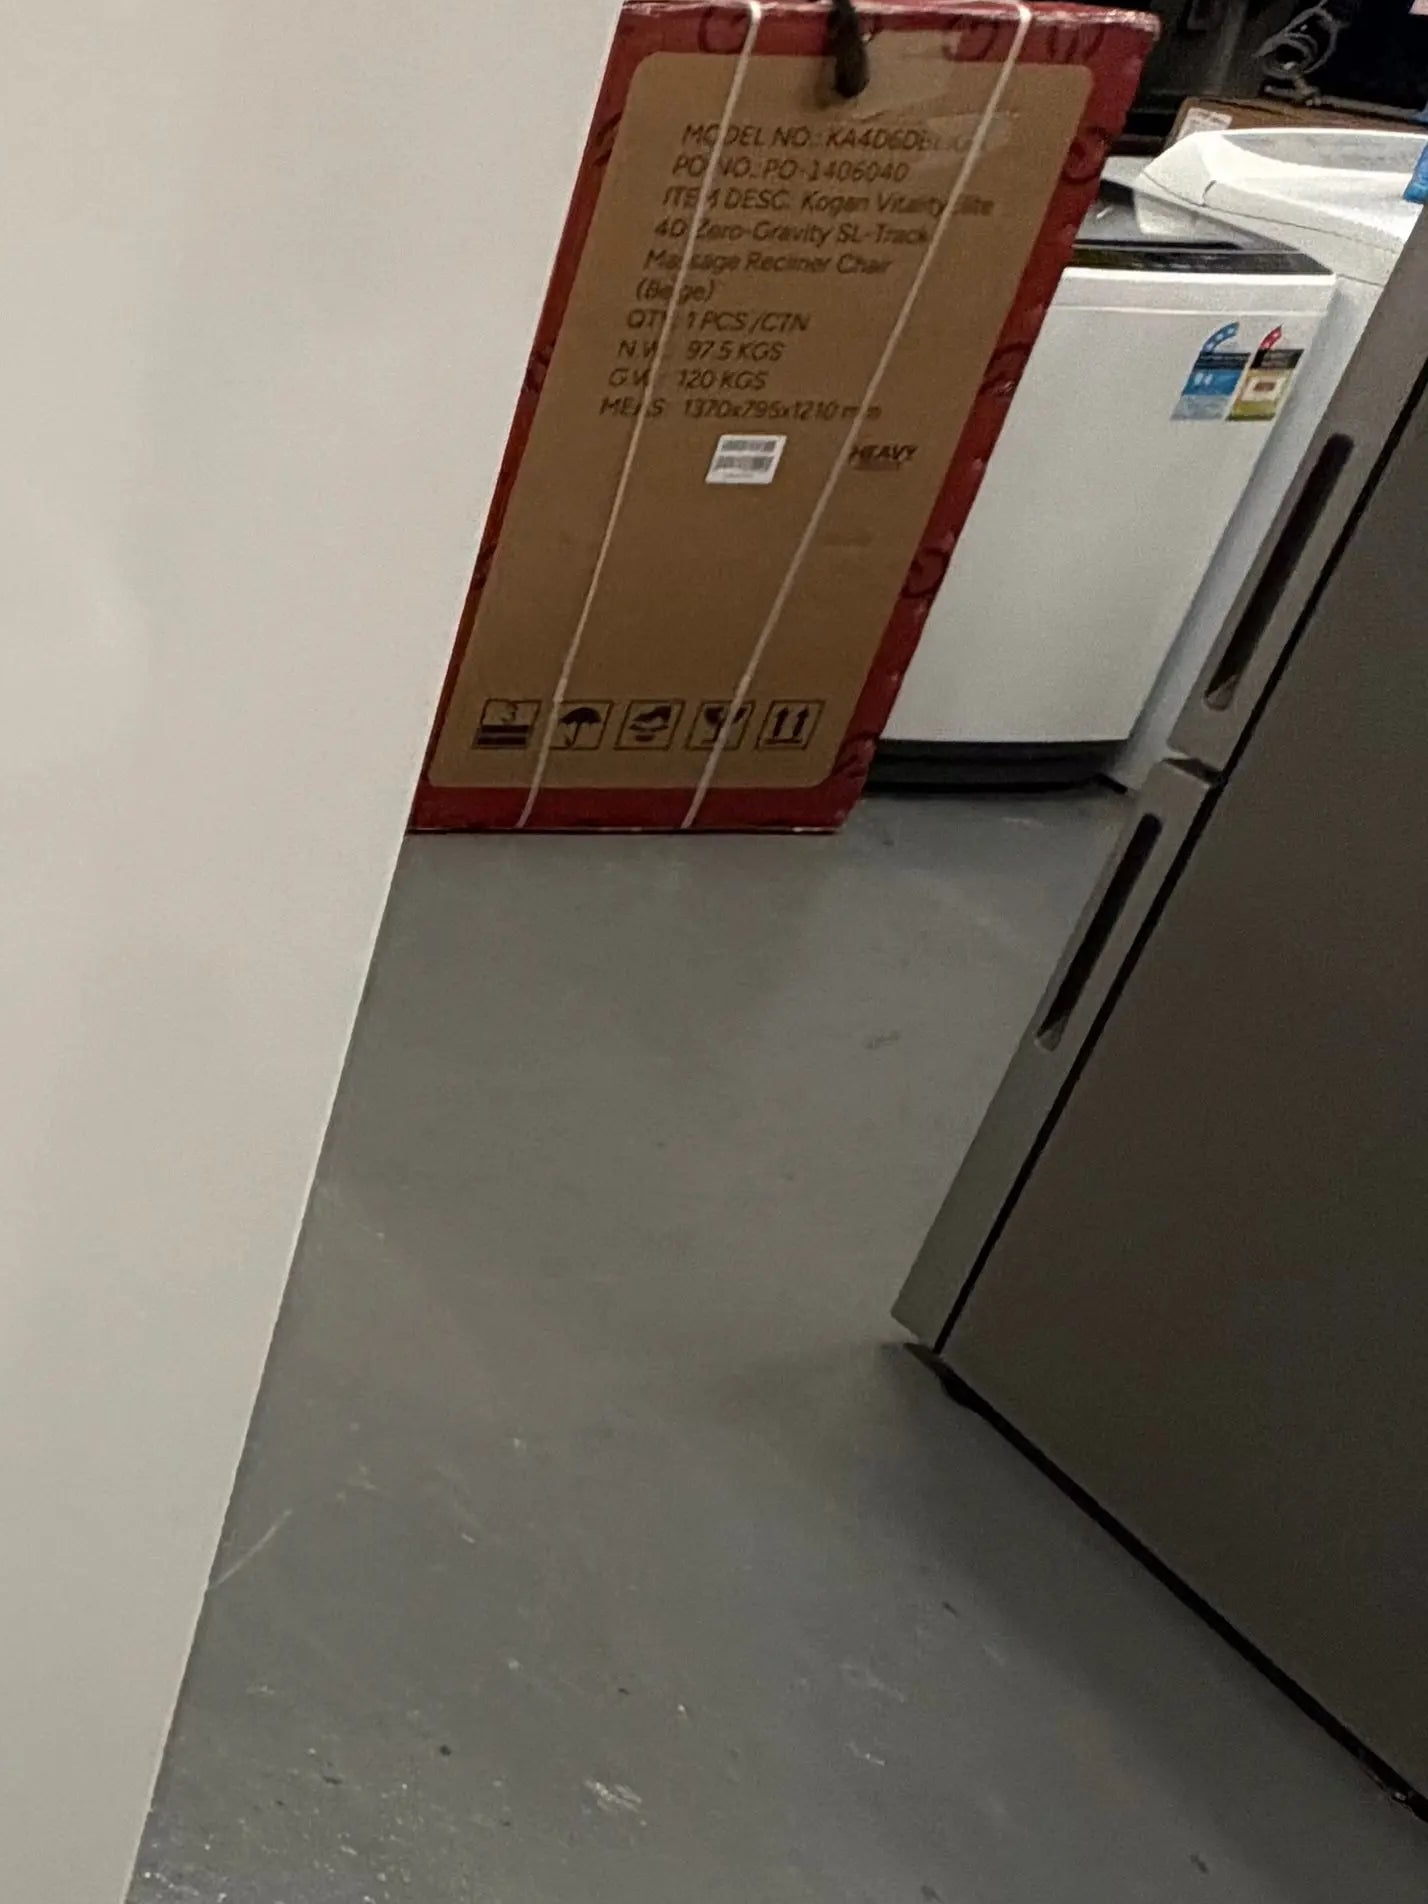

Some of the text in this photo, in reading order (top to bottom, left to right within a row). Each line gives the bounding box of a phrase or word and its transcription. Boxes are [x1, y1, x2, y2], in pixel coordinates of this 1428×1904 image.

[682, 123, 766, 147] MODEL
[672, 154, 707, 178] PO
[692, 218, 833, 247] Zero-Gravity
[643, 249, 741, 275] Masage
[635, 277, 715, 305] (Bege)
[677, 367, 715, 390] 120
